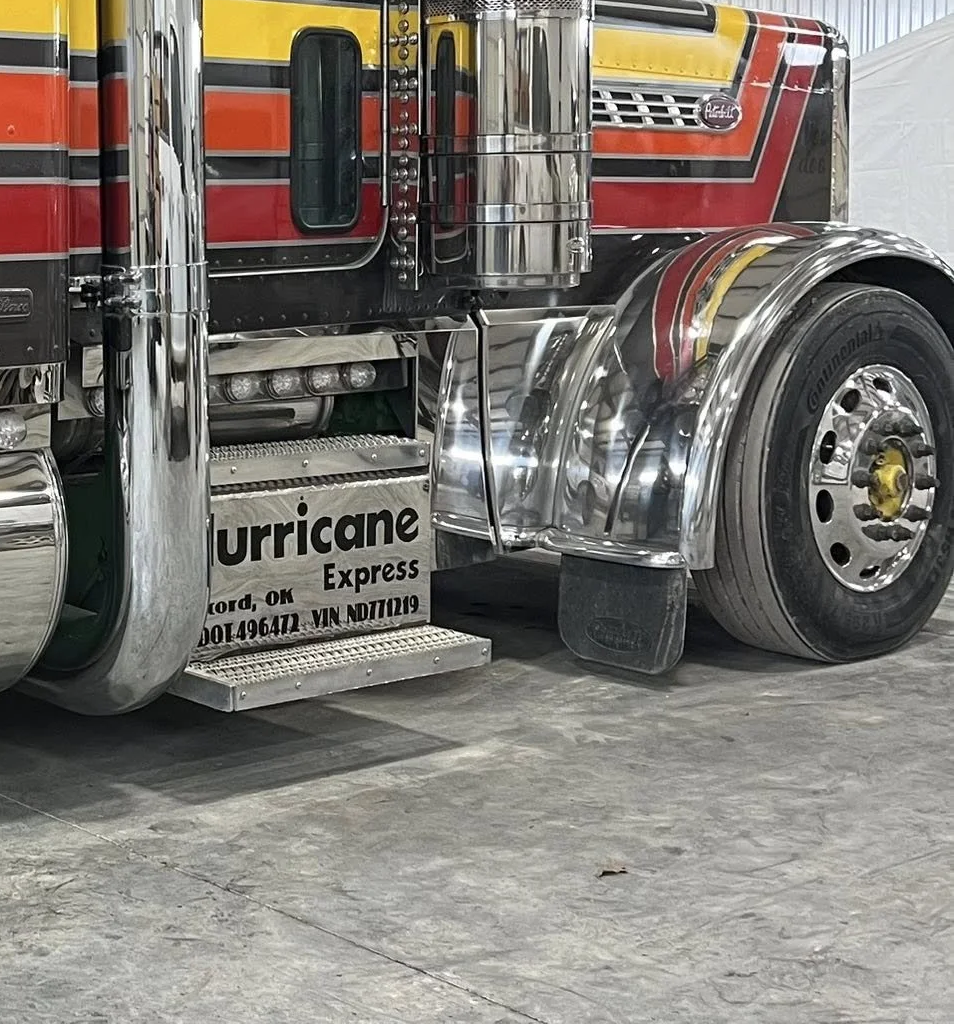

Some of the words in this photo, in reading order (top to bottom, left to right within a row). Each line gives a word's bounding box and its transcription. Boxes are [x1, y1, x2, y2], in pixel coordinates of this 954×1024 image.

[806, 322, 872, 416] Continental
[210, 496, 419, 566] urricane
[265, 587, 294, 607] OK
[323, 559, 419, 593] Express
[235, 612, 300, 641] 496472
[311, 606, 340, 628] VIN
[347, 595, 419, 623] ND771219
